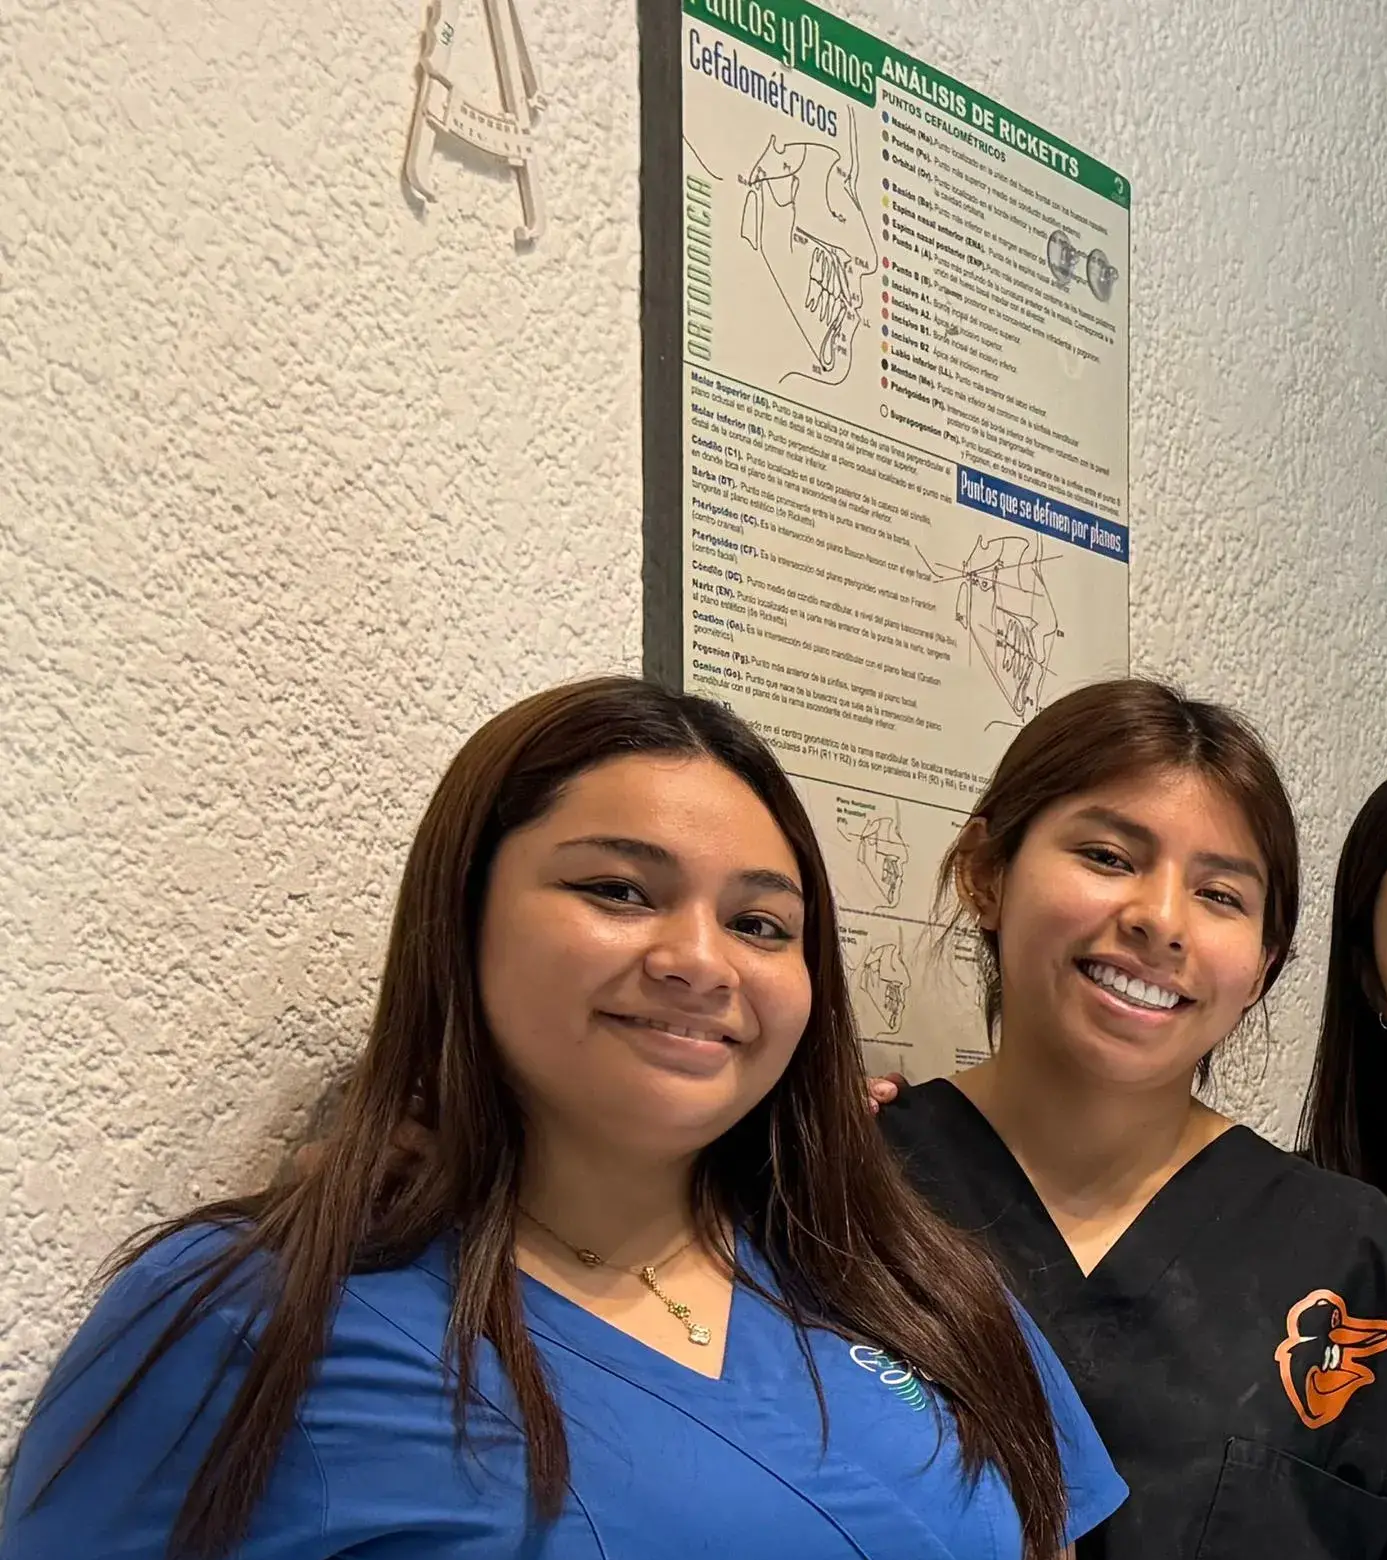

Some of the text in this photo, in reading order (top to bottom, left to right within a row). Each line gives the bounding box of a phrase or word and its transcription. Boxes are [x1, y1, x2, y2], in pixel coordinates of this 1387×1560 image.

[689, 27, 838, 138] Cefalométricos
[690, 0, 873, 95] ntos y Planos
[881, 55, 1080, 179] ANÁLISIS DE RICKETTS
[881, 87, 1006, 164] PUNTOS CEFALOMÉTRICOS
[686, 175, 713, 362] ORTODONCIA
[960, 470, 998, 508] Puntos
[1000, 488, 1018, 513] que
[1019, 496, 1033, 520] se
[1033, 499, 1070, 533] definen
[1071, 516, 1089, 541] por
